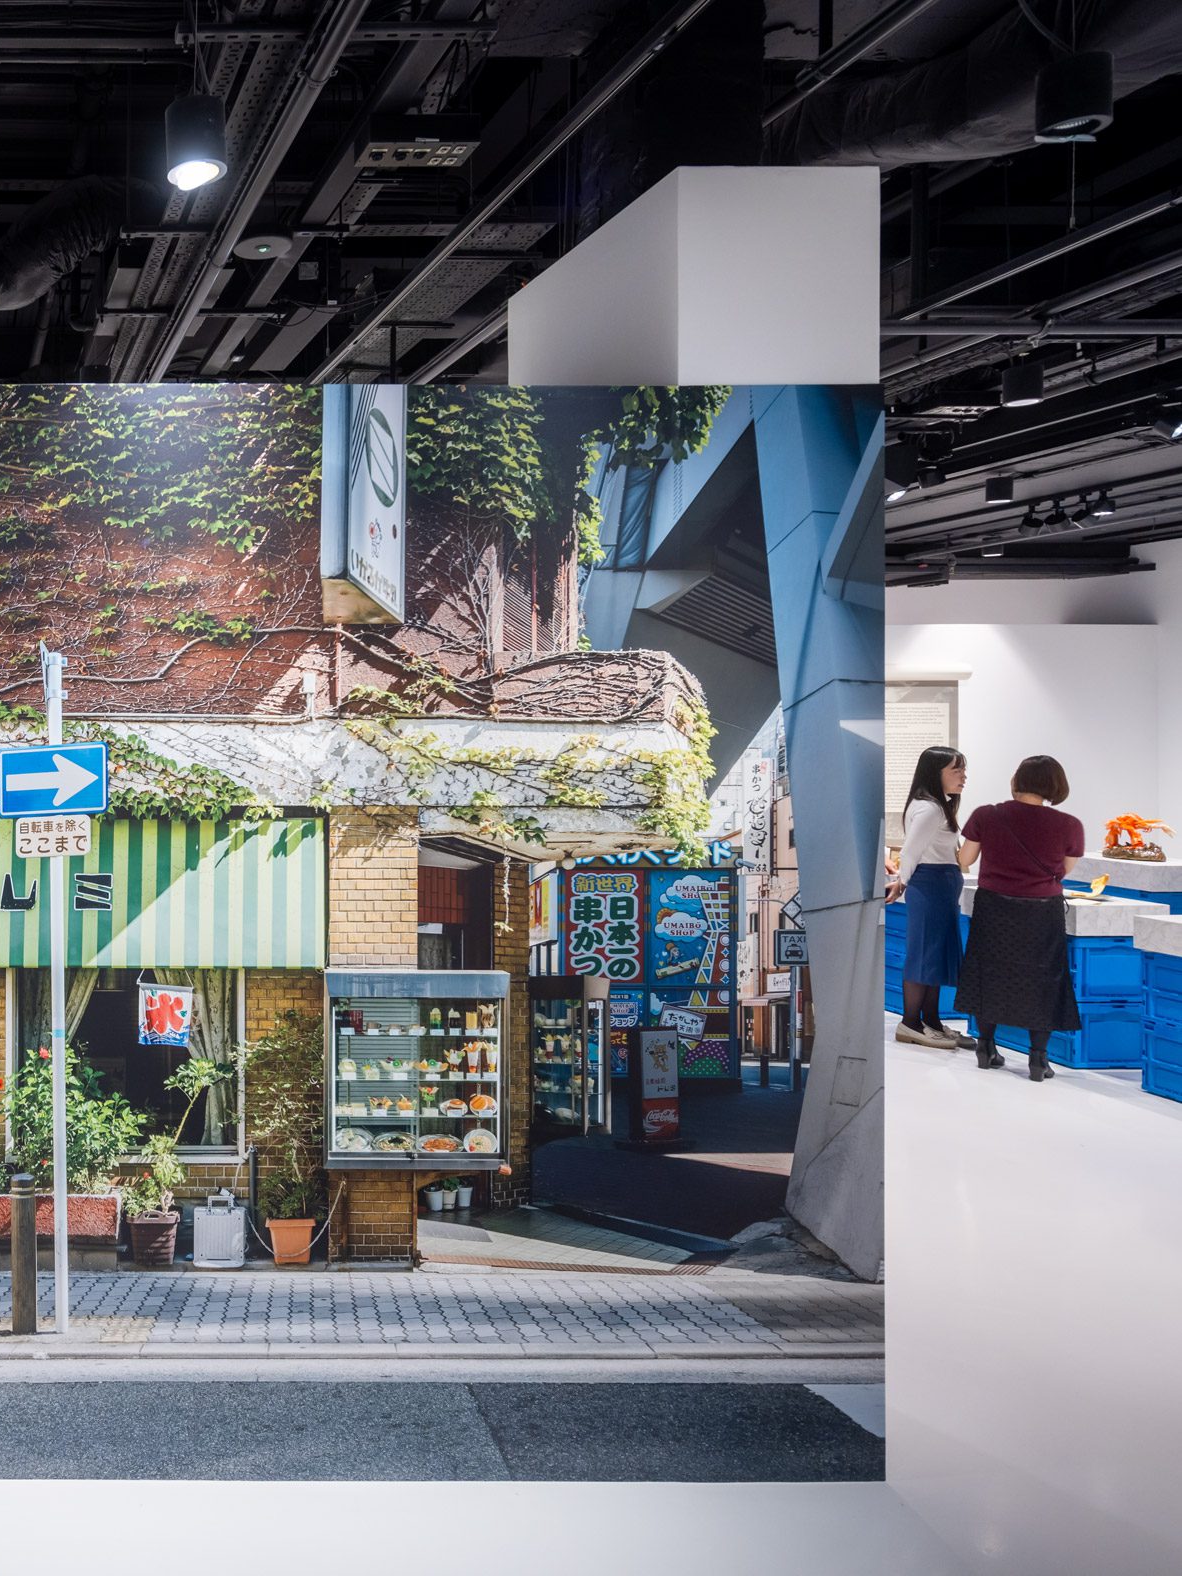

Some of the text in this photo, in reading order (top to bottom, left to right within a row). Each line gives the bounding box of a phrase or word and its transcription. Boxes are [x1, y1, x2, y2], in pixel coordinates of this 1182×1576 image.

[19, 820, 87, 834] 自転車を除く
[19, 836, 88, 854] ここまで
[574, 875, 635, 893] 新世界
[573, 896, 603, 976] 串かつ
[608, 896, 636, 978] 日本一の
[146, 994, 184, 1034] 氷
